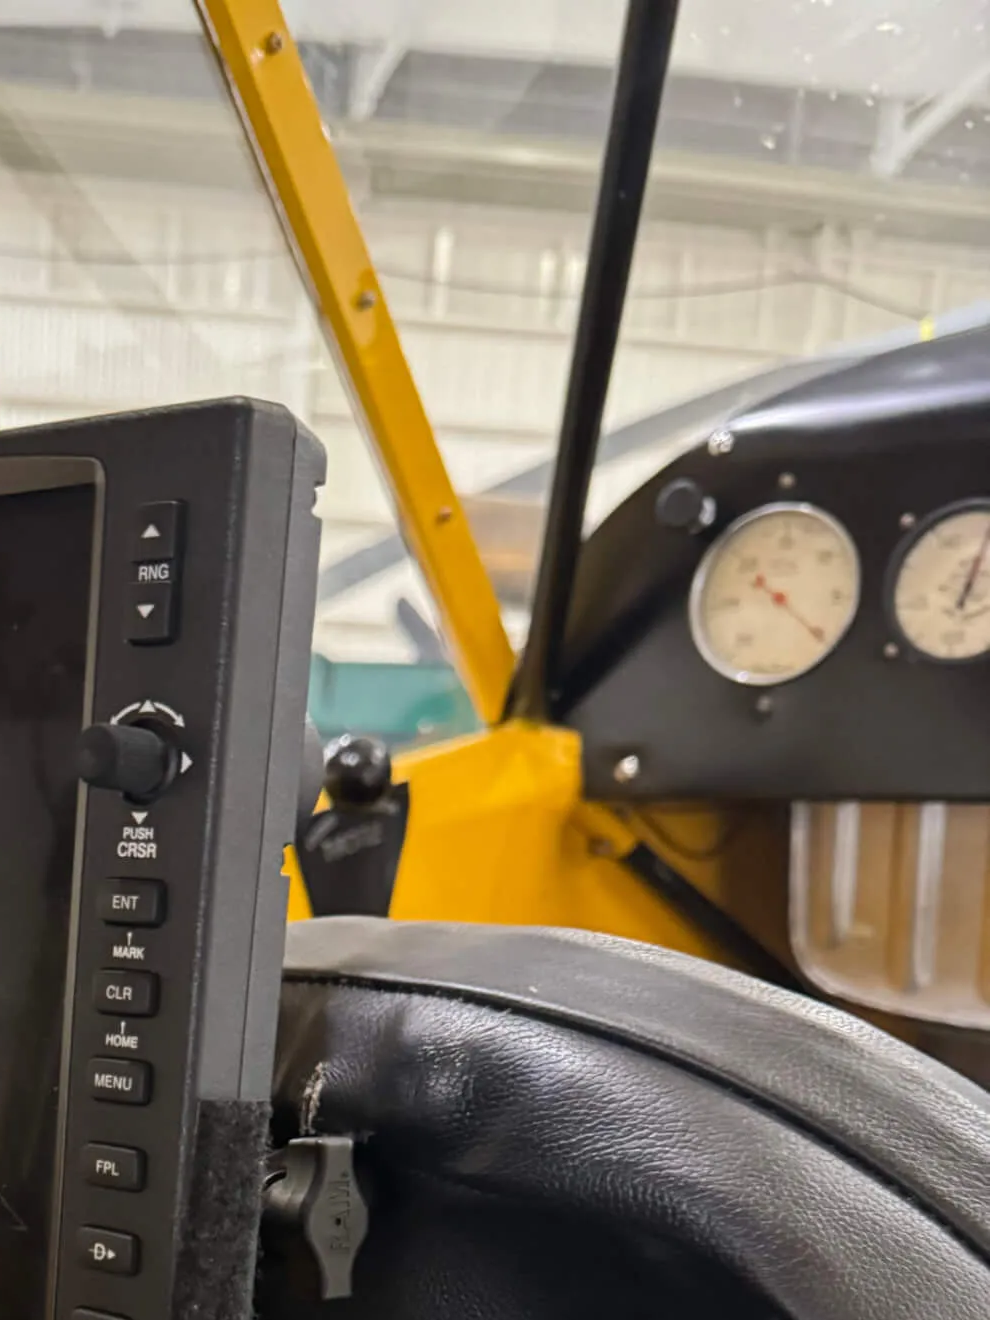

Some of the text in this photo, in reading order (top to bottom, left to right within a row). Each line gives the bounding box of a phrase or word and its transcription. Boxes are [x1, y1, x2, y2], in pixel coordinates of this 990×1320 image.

[138, 564, 169, 581] RNG
[122, 826, 154, 840] PUSH
[117, 841, 157, 859] CRSR
[112, 895, 139, 911] ENT
[112, 945, 145, 960] MARK
[105, 985, 133, 1001] CLR
[105, 1033, 139, 1049] HOME
[94, 1073, 133, 1091] MENU
[96, 1159, 119, 1176] FPL
